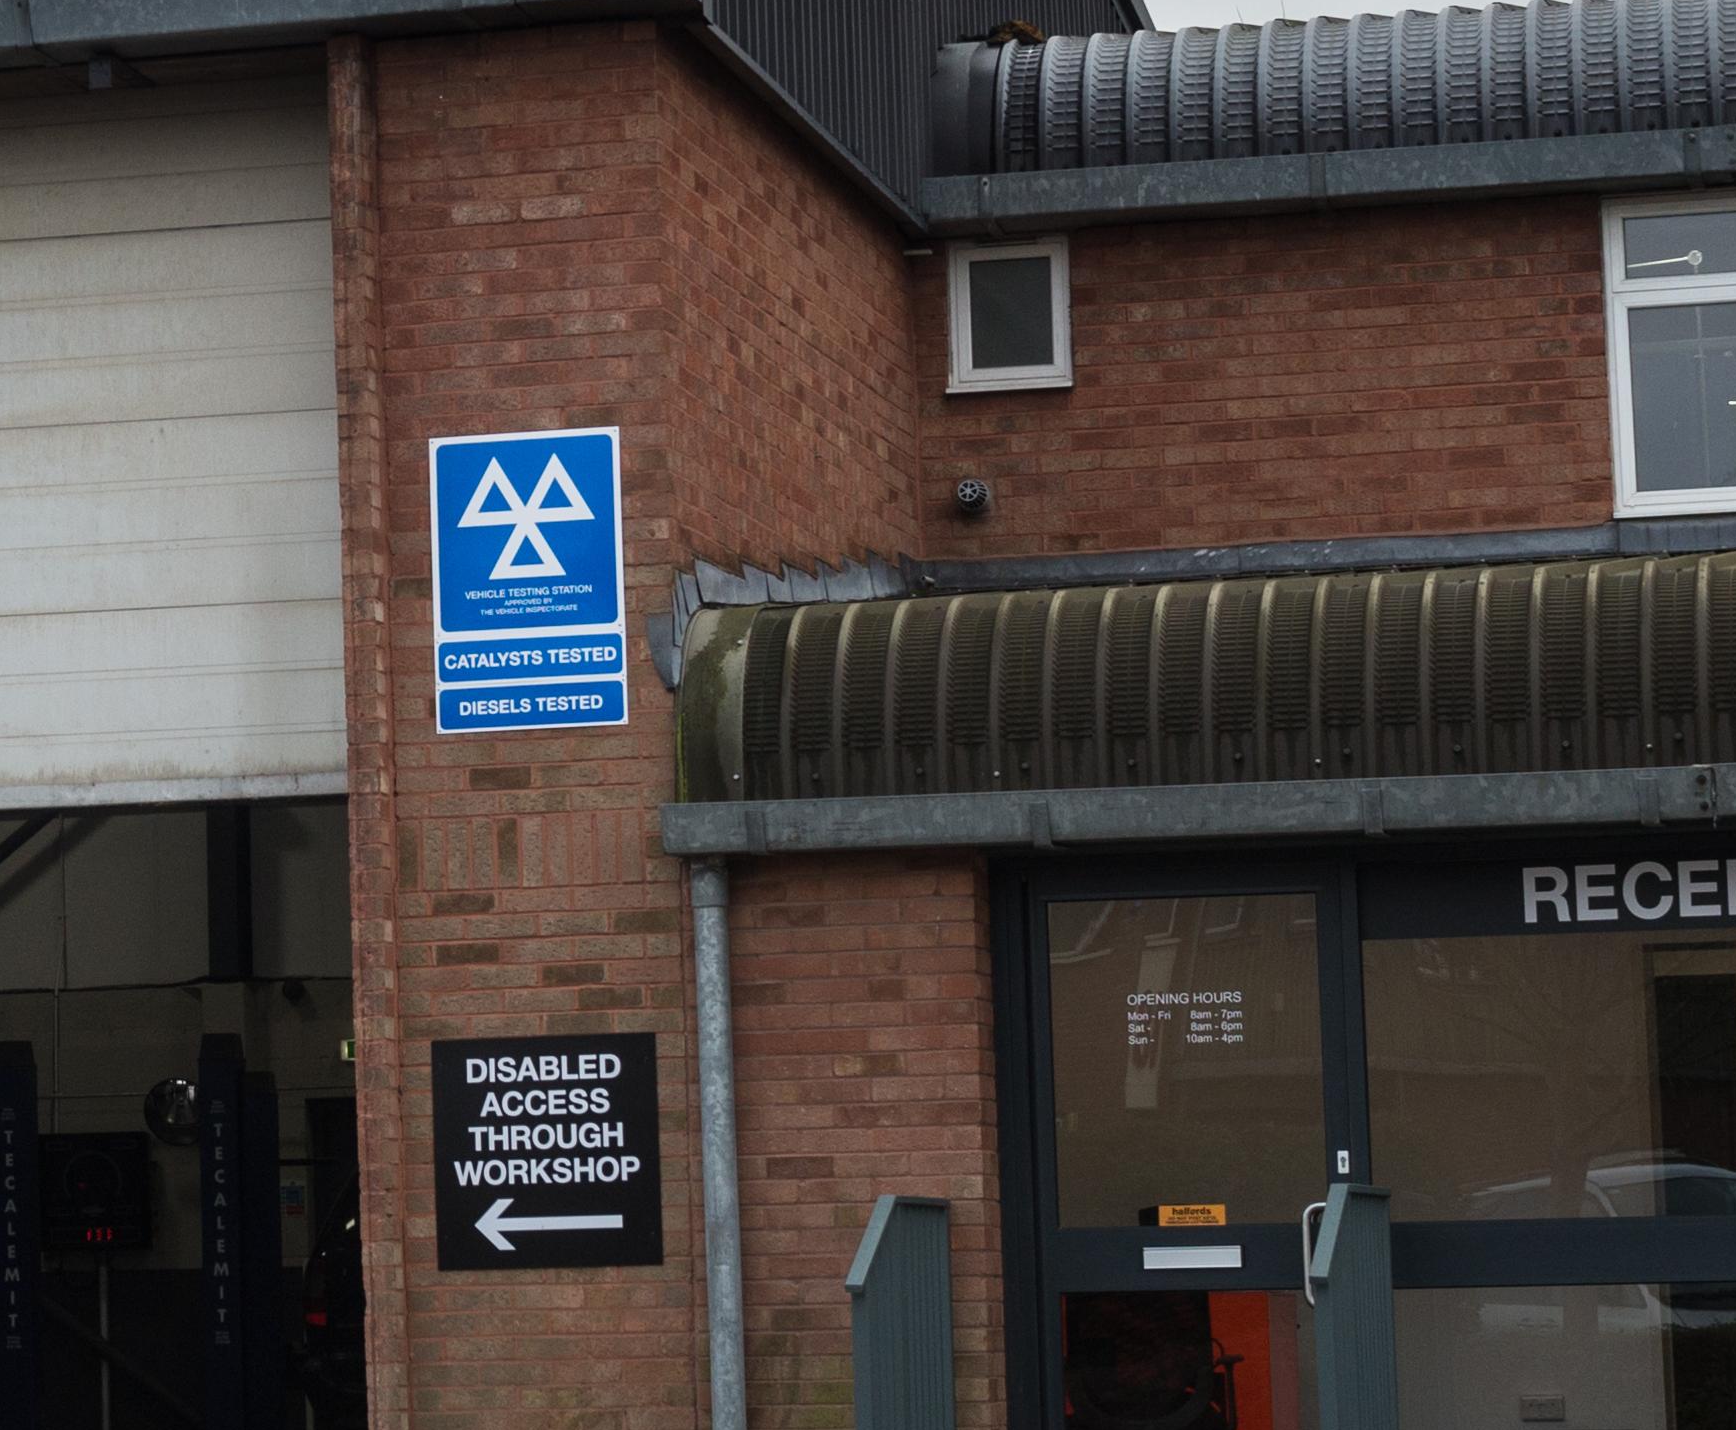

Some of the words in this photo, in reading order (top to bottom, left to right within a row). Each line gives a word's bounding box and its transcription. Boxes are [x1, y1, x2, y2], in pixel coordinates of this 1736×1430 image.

[465, 588, 505, 600] VEHICLE
[508, 586, 550, 597] TESTING
[552, 584, 593, 595] STATION
[444, 649, 543, 671] CATALYSTS
[547, 646, 617, 665] TESTED
[459, 697, 532, 717] DIESELS
[536, 694, 603, 713] TESTED
[1126, 992, 1189, 1006] OPENING
[1193, 991, 1242, 1003] HOURS
[1127, 1012, 1149, 1021] Mon
[1158, 1011, 1171, 1020] Fri
[1190, 1010, 1212, 1019] 8am
[1221, 1009, 1243, 1020] 7pm
[1128, 1023, 1145, 1033] Sat
[1190, 1022, 1212, 1031] 8am
[1221, 1021, 1243, 1032] 6pm
[1128, 1035, 1148, 1045] Sun
[1186, 1034, 1213, 1043] 10am
[1221, 1033, 1243, 1044] 4pm
[466, 1053, 622, 1084] DISABLED
[480, 1088, 611, 1117] ACCESS
[468, 1122, 624, 1151] THROUGH
[454, 1156, 641, 1186] WORKSHOP
[3, 1129, 21, 1329] TECALEMIT
[213, 1122, 229, 1325] TECALEMIT
